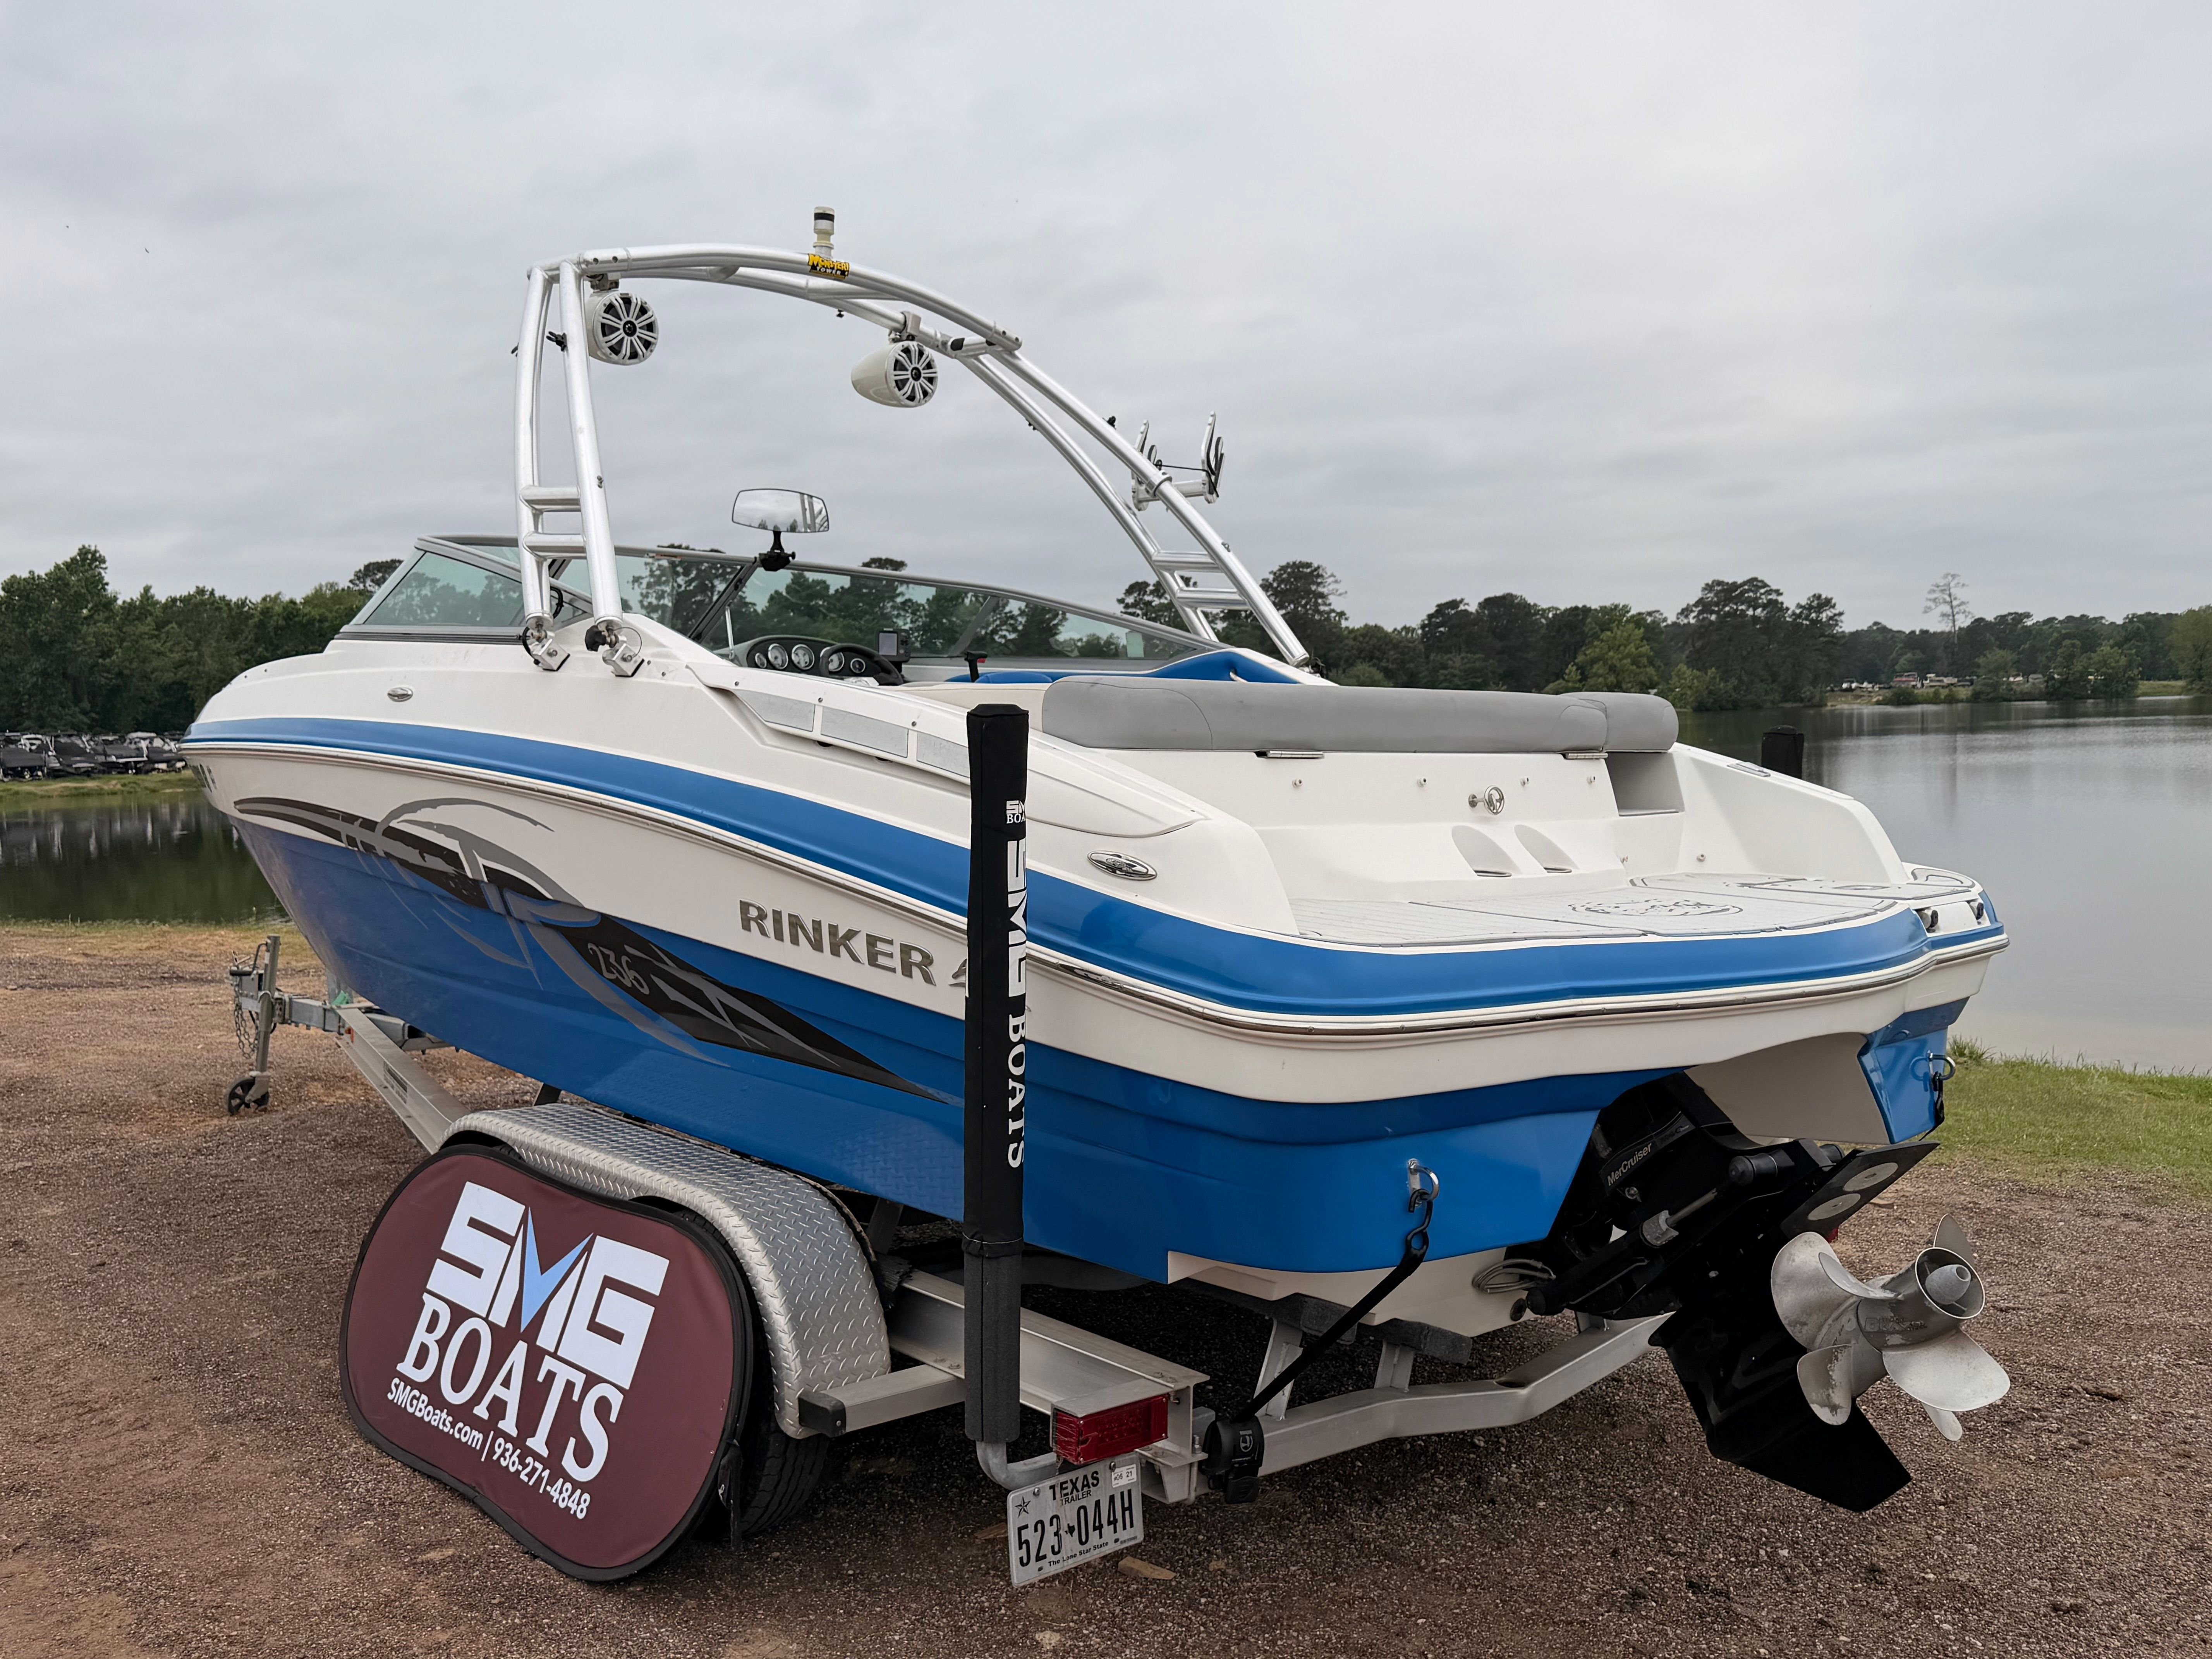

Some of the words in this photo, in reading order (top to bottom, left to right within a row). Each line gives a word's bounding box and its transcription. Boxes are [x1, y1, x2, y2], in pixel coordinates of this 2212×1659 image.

[587, 943, 650, 995] 236
[739, 898, 937, 986] RINKER
[1008, 1014, 1025, 1168] BOATS
[1607, 1143, 1652, 1187] MerCruiser
[426, 1181, 670, 1390] SMG
[396, 1292, 624, 1482] BOATS
[387, 1377, 484, 1451] SMGBoats.com
[492, 1437, 591, 1520] 936-271-4848
[1049, 1470, 1100, 1501] TEXAS
[1017, 1514, 1063, 1568] 523
[1076, 1488, 1134, 1546] 044H
[1060, 1489, 1092, 1506] TRAILER
[1062, 1553, 1077, 1562] Lone
[1079, 1548, 1091, 1556] Star
[1093, 1541, 1109, 1551] State
